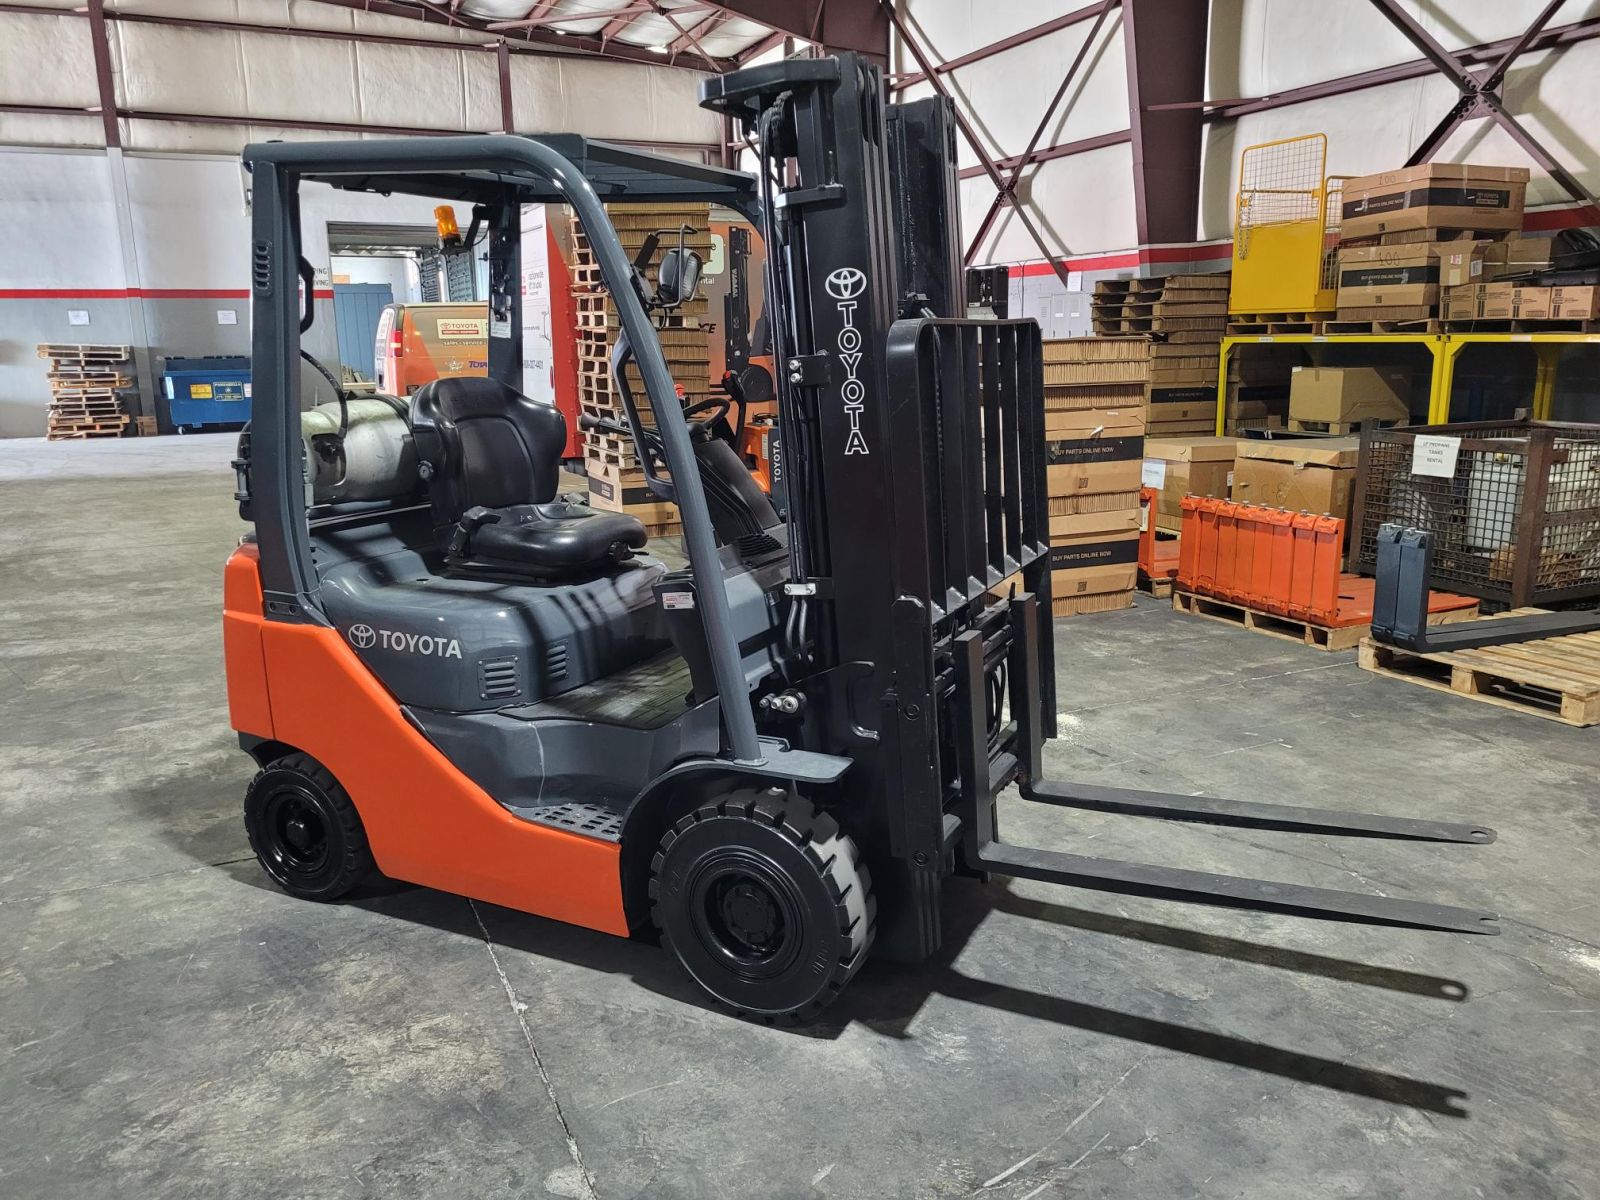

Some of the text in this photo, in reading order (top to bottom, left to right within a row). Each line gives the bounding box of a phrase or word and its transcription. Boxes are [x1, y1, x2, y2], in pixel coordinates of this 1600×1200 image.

[837, 301, 870, 455] TOYOTA
[773, 440, 782, 483] TOYOTA
[379, 629, 462, 659] TOYOTA
